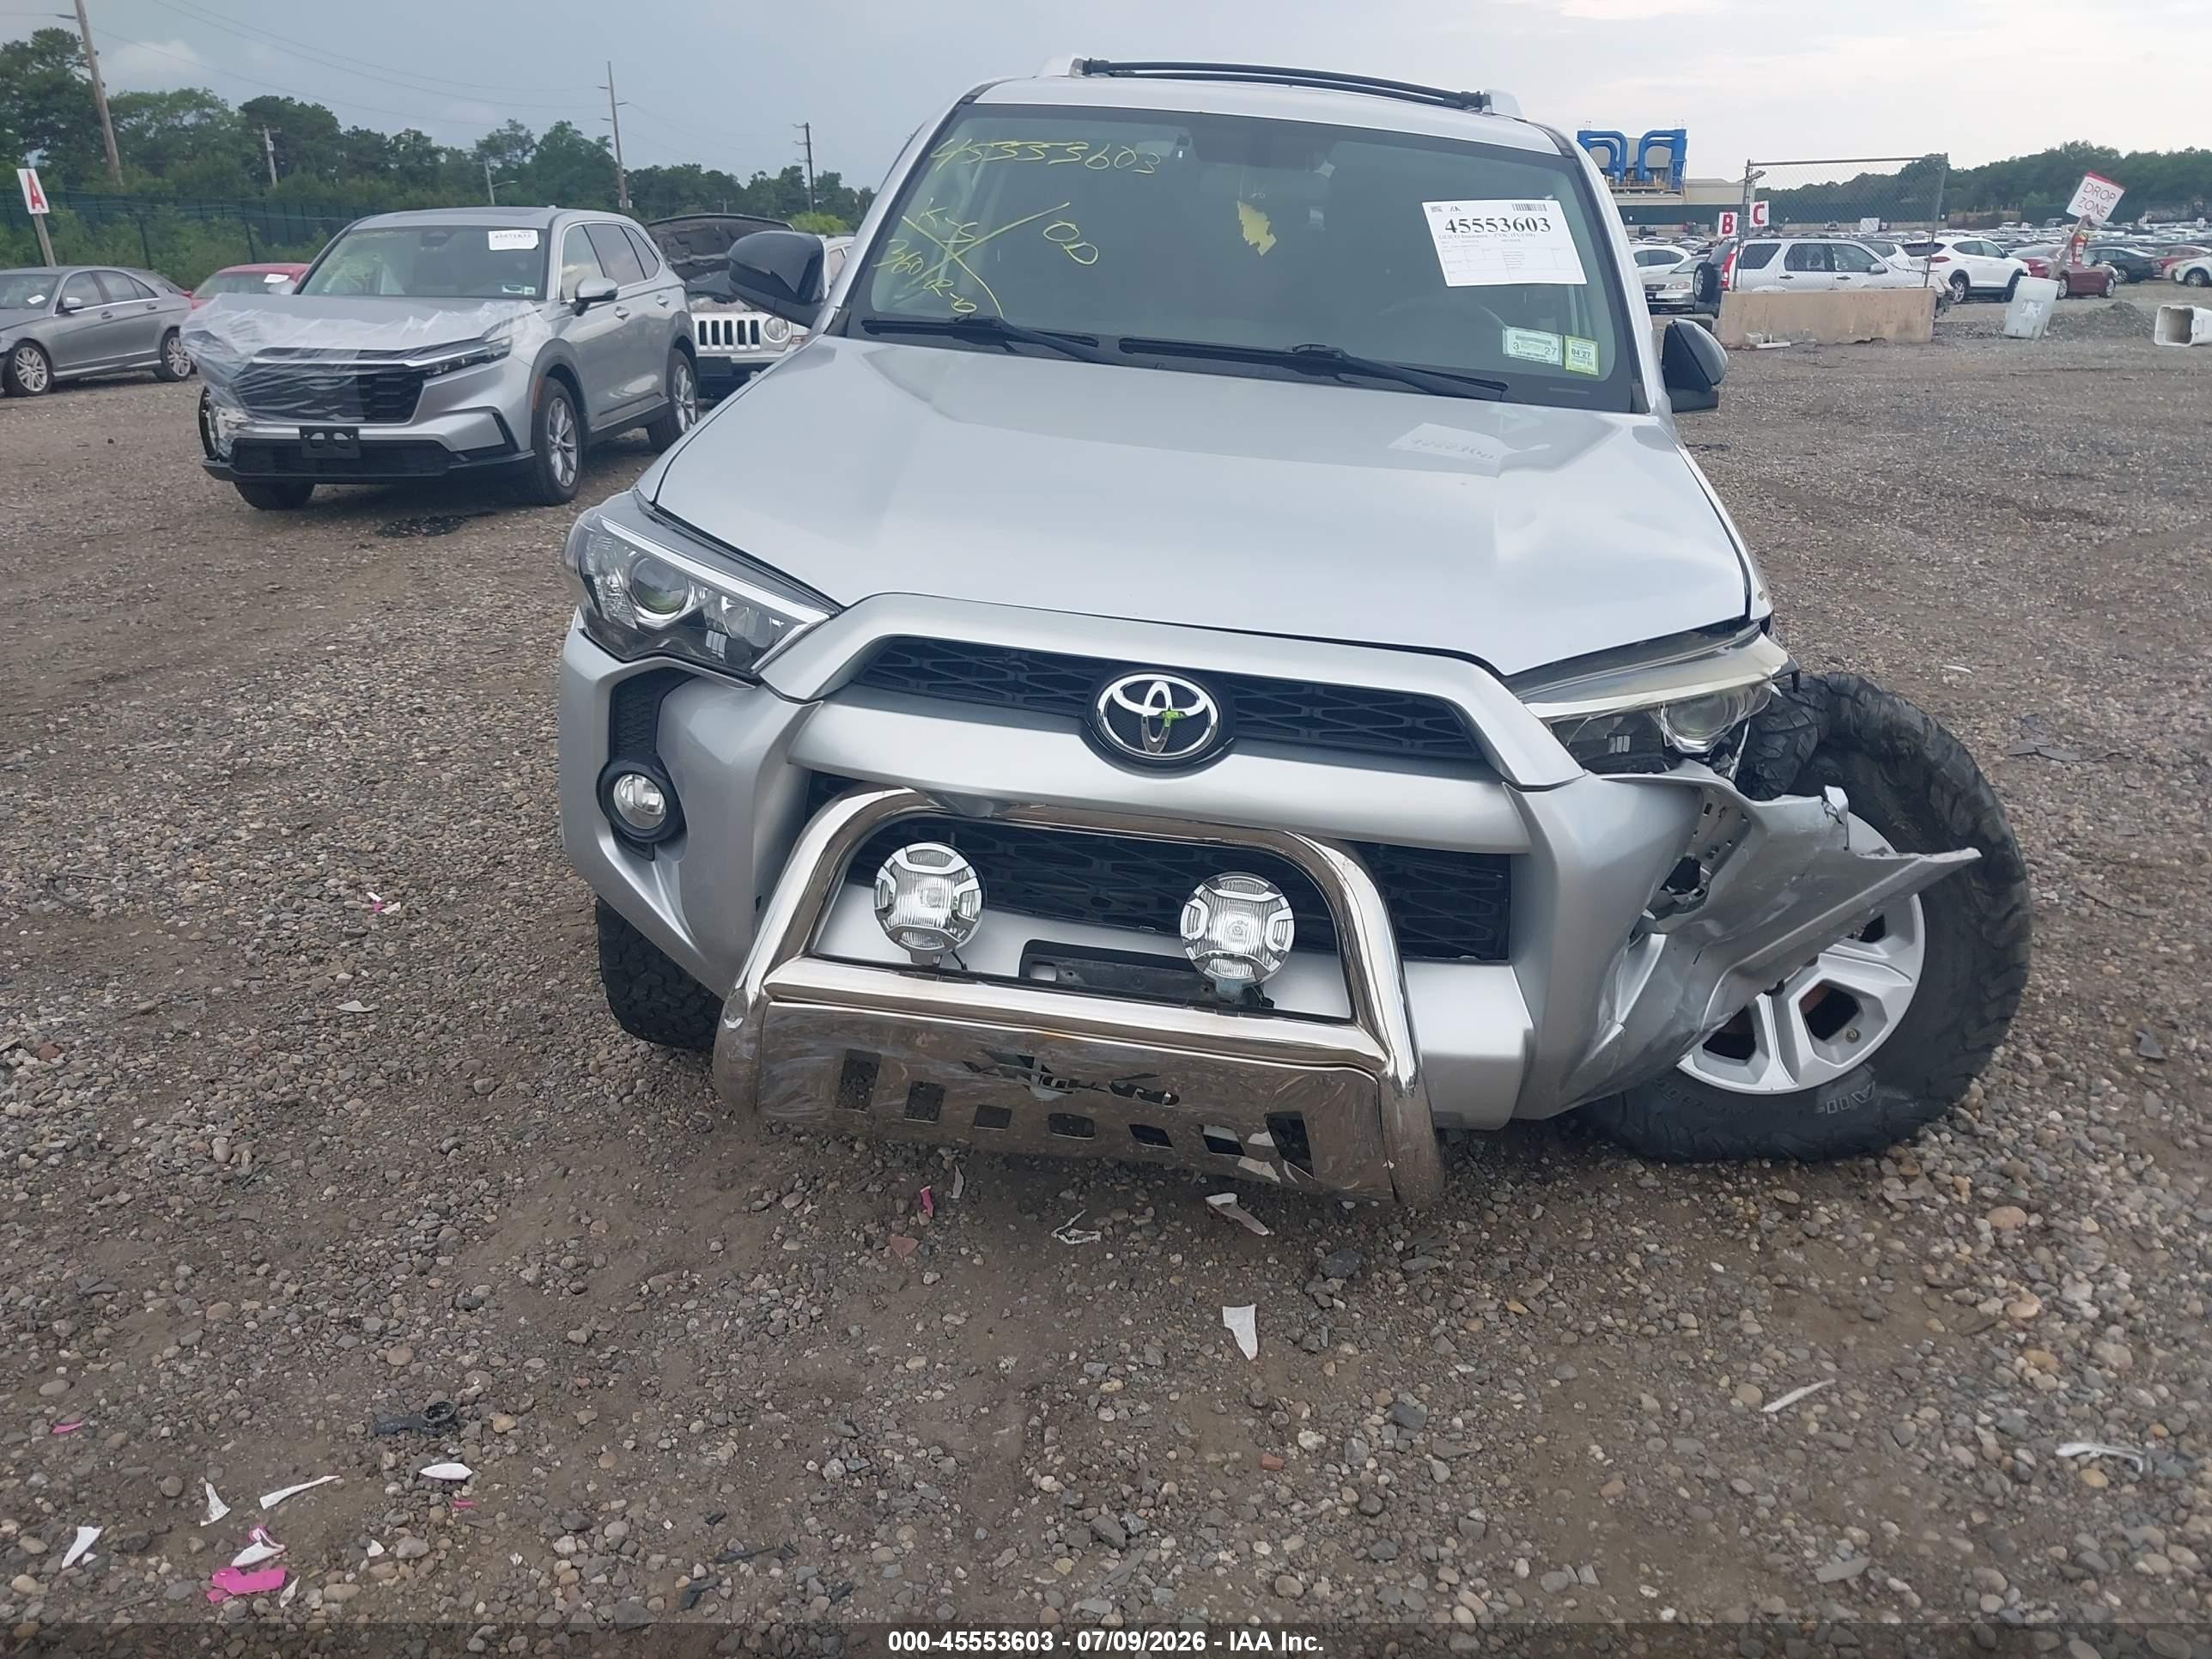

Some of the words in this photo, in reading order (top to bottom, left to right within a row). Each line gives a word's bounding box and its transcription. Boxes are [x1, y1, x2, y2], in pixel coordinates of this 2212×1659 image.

[27, 170, 46, 210] A
[2083, 182, 2117, 203] DROP
[1753, 204, 1765, 225] C
[2077, 197, 2109, 218] ZONE
[1444, 216, 1551, 234] 45553603
[1722, 214, 1734, 234] B
[1544, 346, 1559, 356] 27
